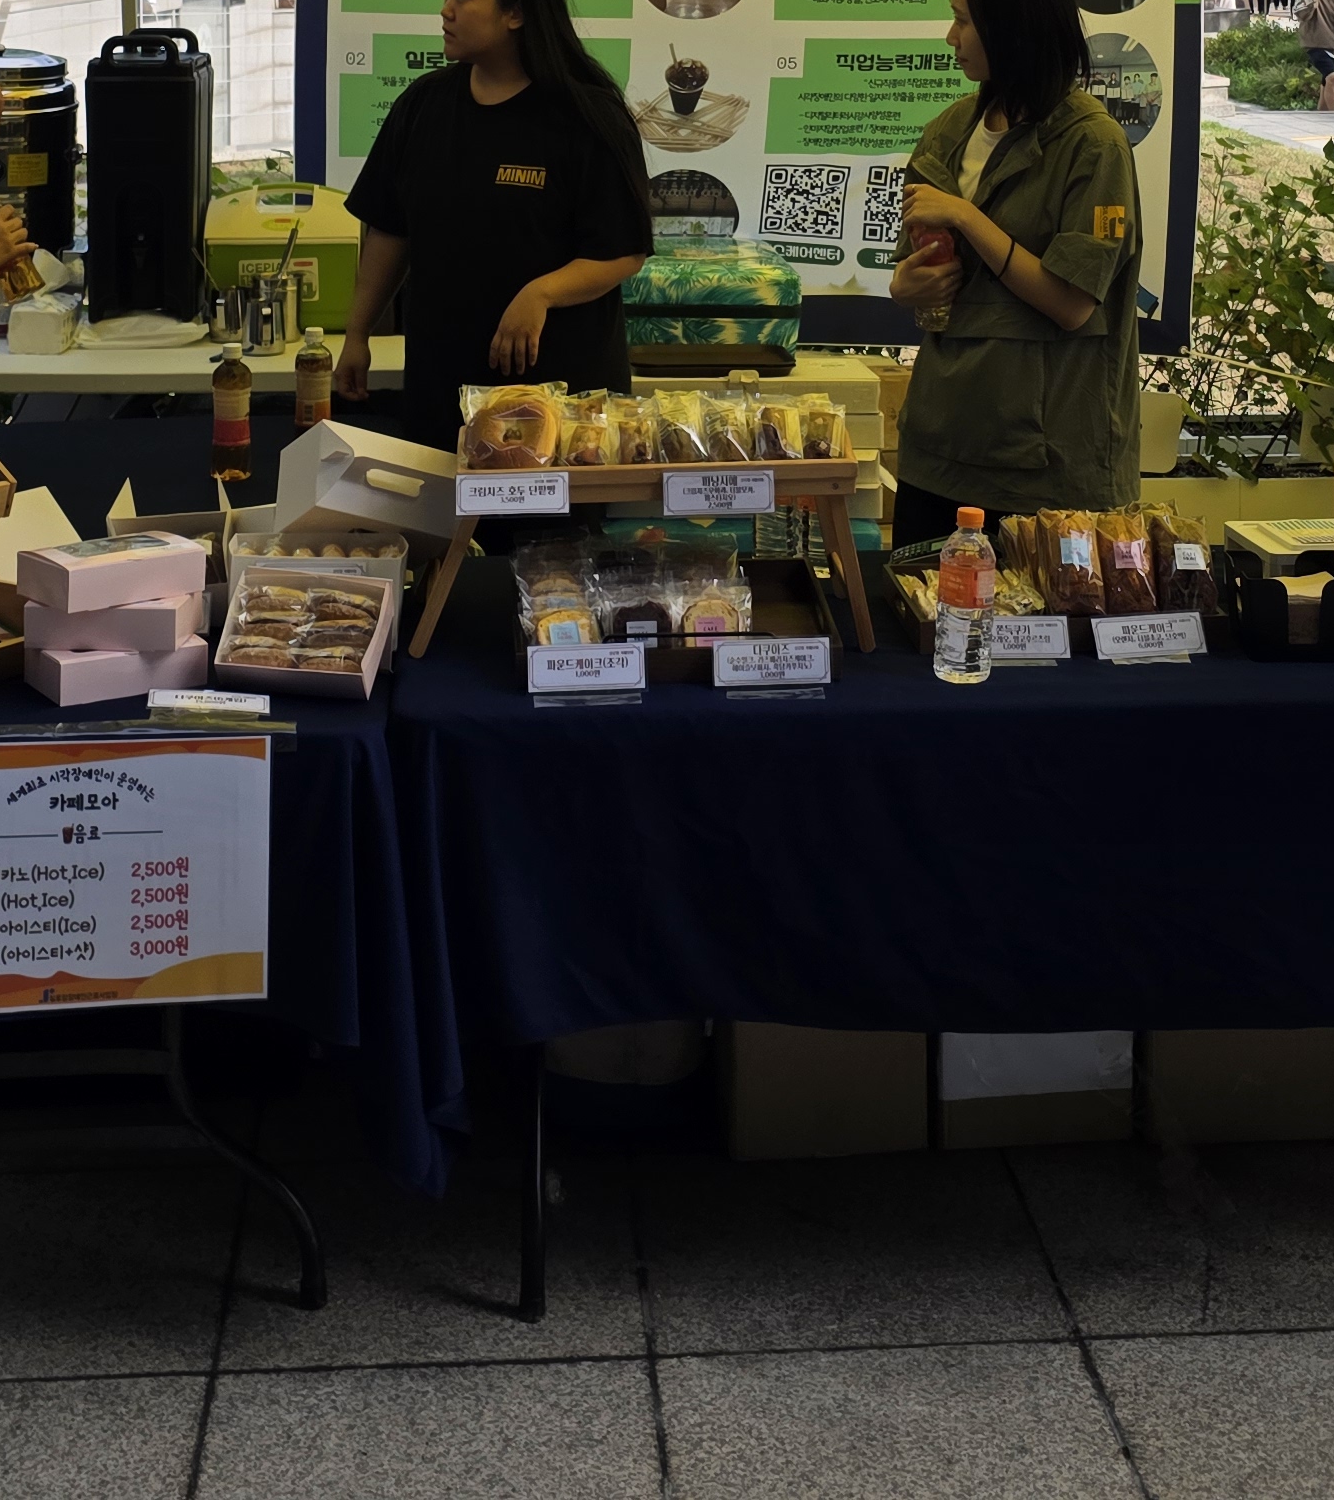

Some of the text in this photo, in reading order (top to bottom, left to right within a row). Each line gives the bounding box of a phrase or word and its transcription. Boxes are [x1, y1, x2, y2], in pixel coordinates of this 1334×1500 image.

[346, 52, 365, 65] 02
[777, 57, 797, 70] 05
[496, 168, 546, 186] MINIM
[468, 486, 525, 497] 크림치즈 호두
[1122, 623, 1174, 635] 파운드케이크
[546, 658, 629, 670] 파운드케이크(조각)
[49, 793, 119, 812] 카페모아
[74, 824, 101, 844] 음료
[130, 857, 189, 881] 2,500원
[130, 883, 189, 906] 2,500원
[130, 910, 189, 933] 2,500원
[129, 935, 189, 959] 3,000원
